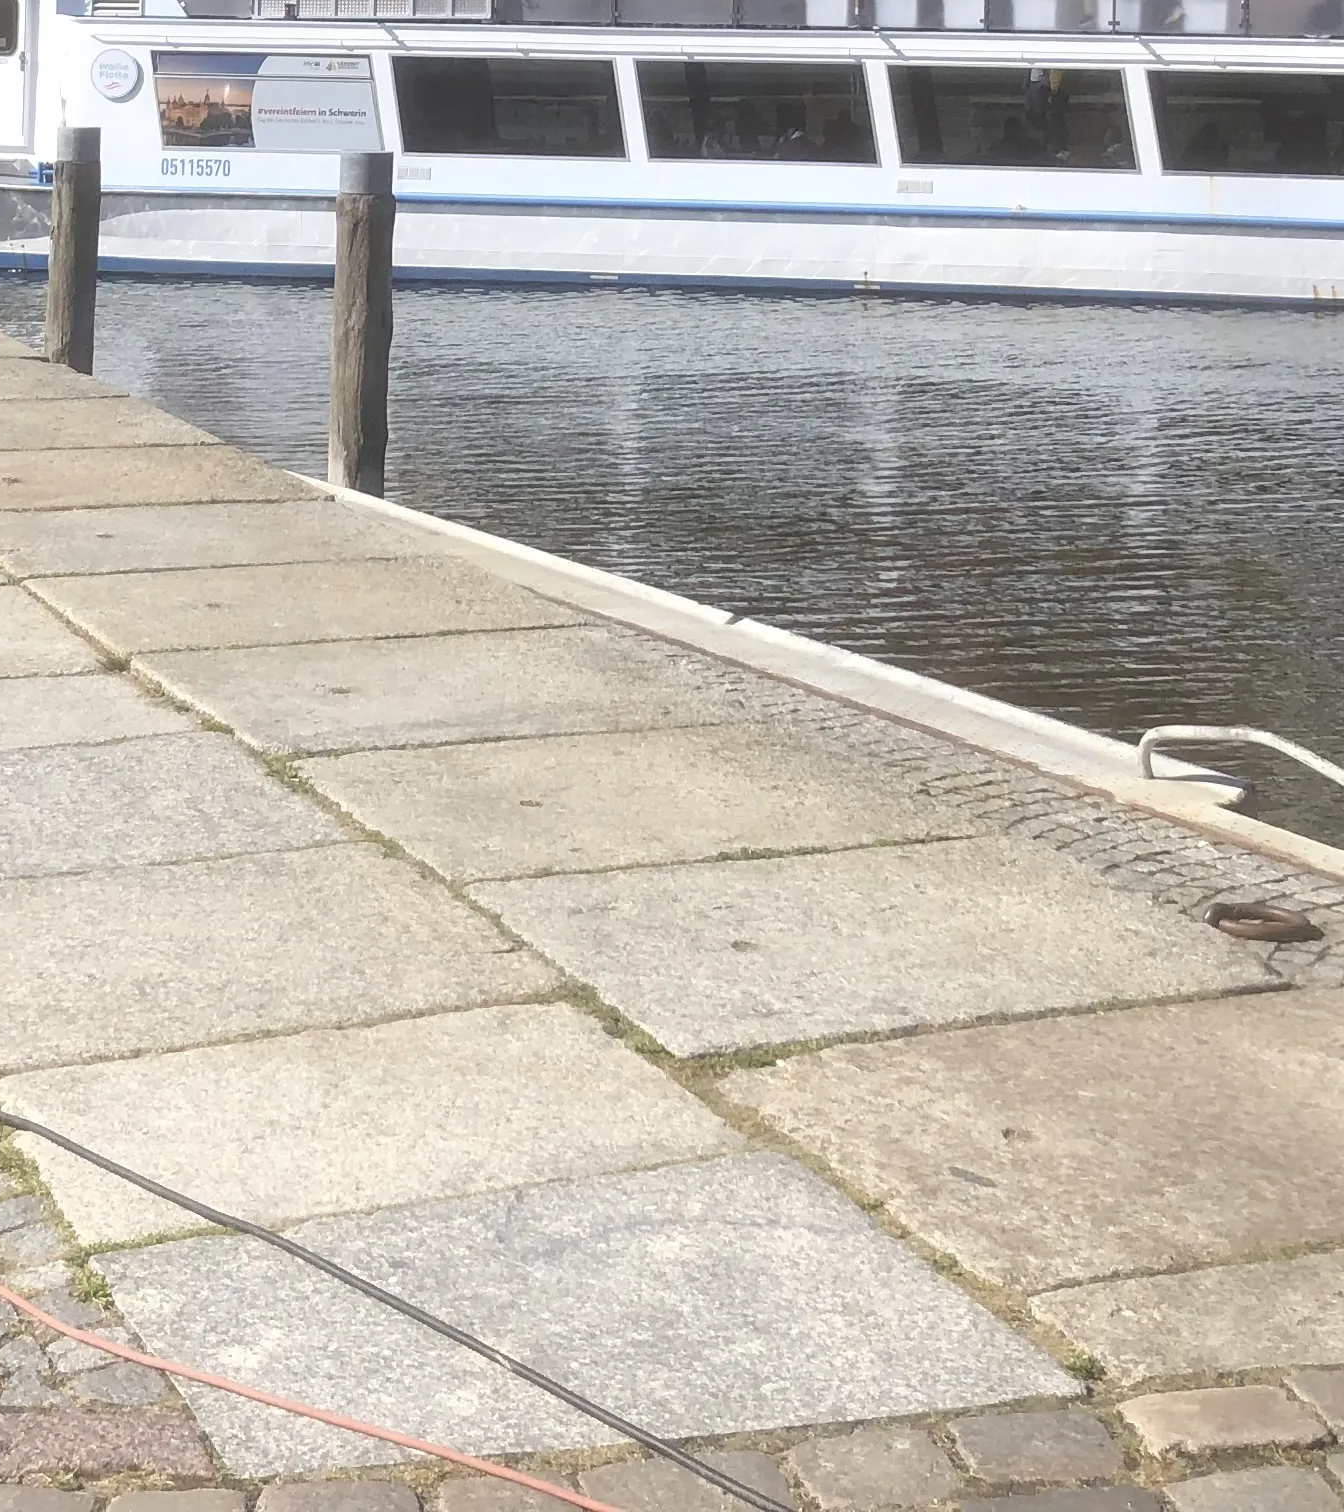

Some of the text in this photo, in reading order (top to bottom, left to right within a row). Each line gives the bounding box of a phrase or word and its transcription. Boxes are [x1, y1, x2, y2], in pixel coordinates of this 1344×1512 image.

[318, 107, 327, 117] in
[328, 108, 367, 118] Schwerin
[161, 158, 231, 177] 05115570
